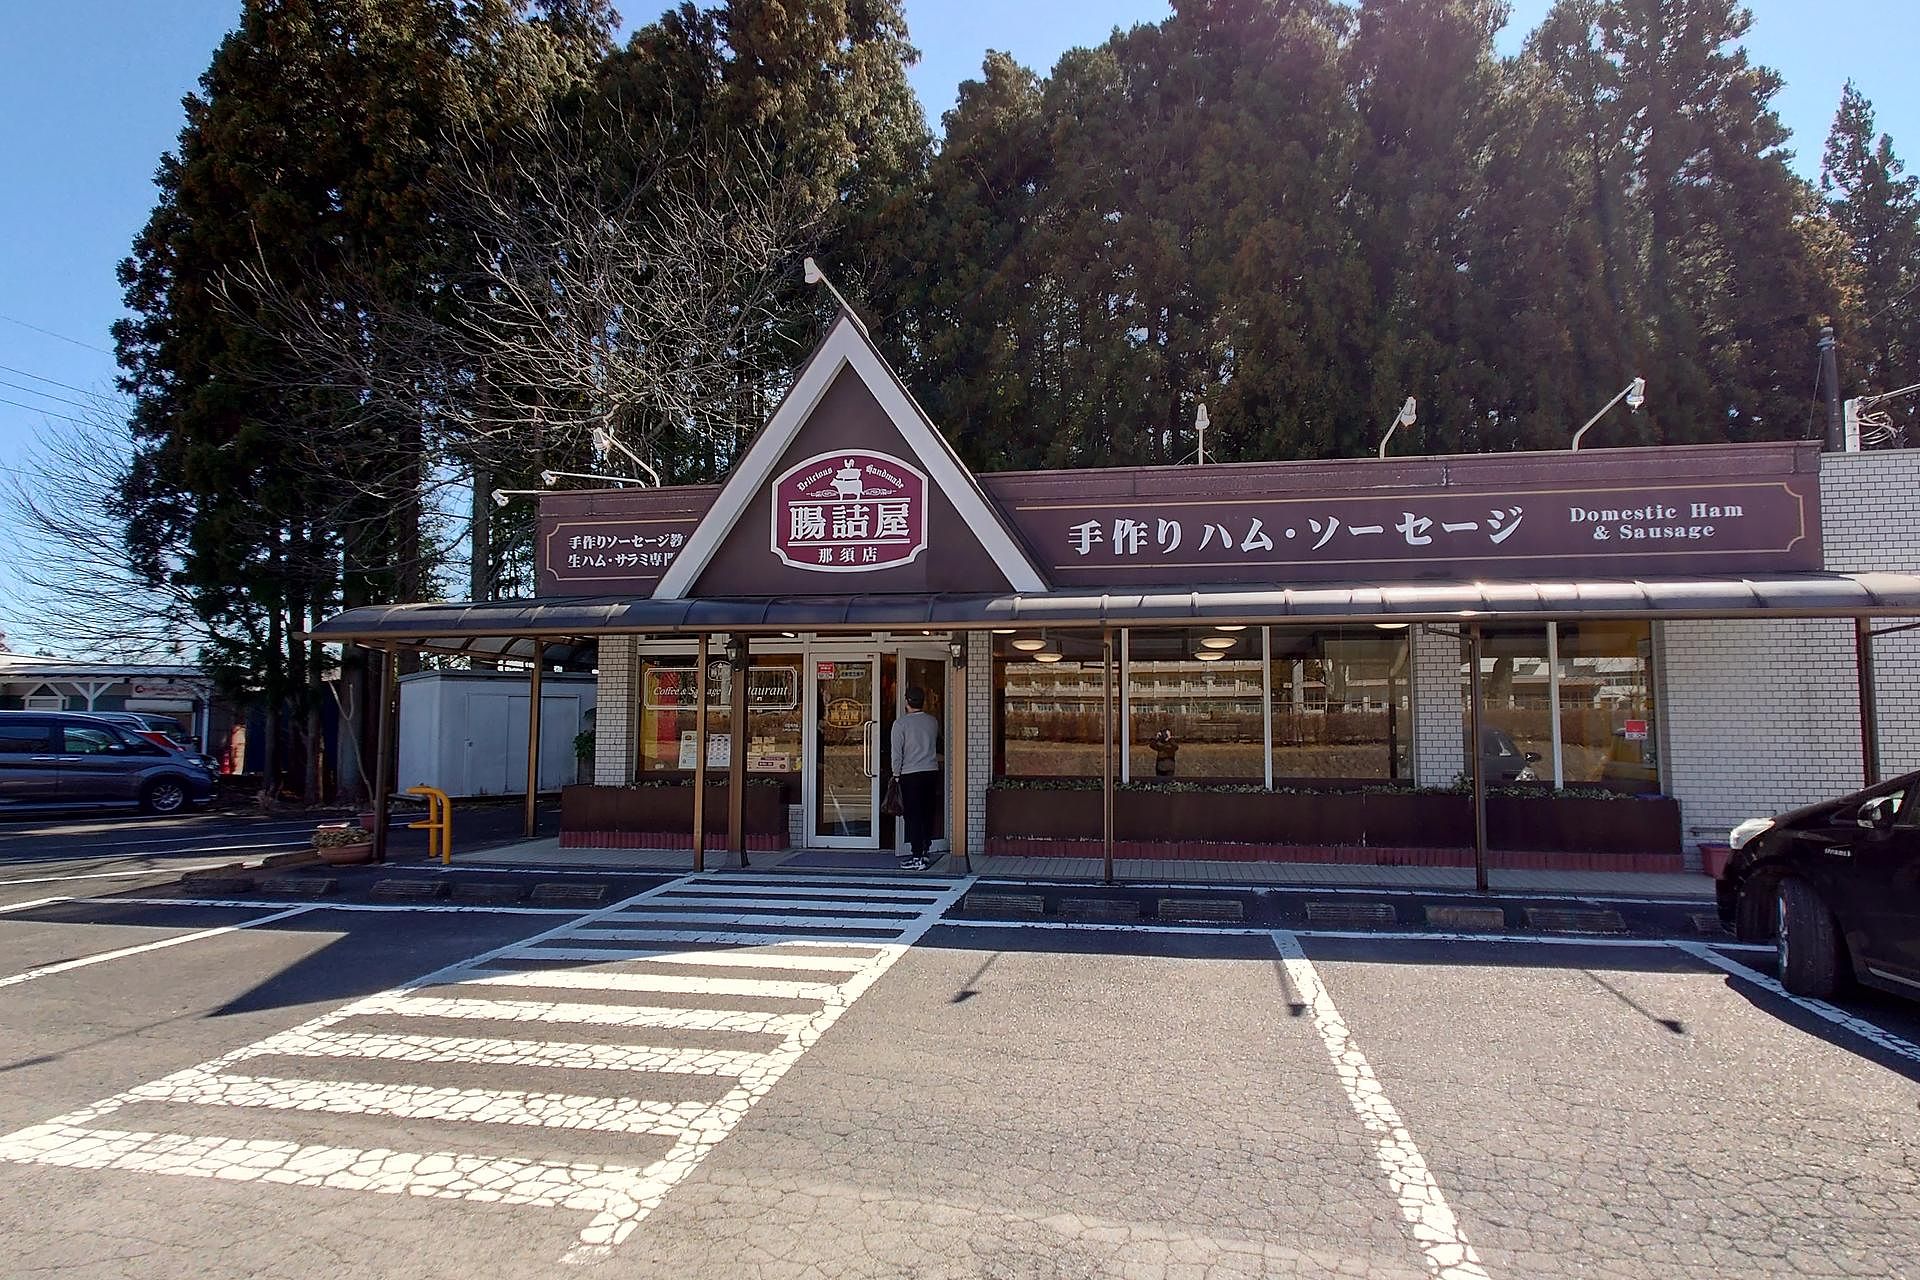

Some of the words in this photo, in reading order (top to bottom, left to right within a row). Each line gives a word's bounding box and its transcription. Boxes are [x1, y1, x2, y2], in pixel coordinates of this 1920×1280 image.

[796, 467, 833, 491] Delicious
[865, 464, 905, 488] Handmade
[789, 503, 910, 540] 腸詰屋
[1569, 504, 1678, 522] Domestic
[1690, 503, 1745, 518] Ham
[1067, 506, 1524, 555] 手作りハム・ソーセージ
[1592, 525, 1611, 540] &
[1619, 524, 1716, 540] Sausage
[568, 533, 687, 549] 手作りソーセージ教
[818, 546, 878, 563] 那須店
[653, 687, 680, 696] Coffee
